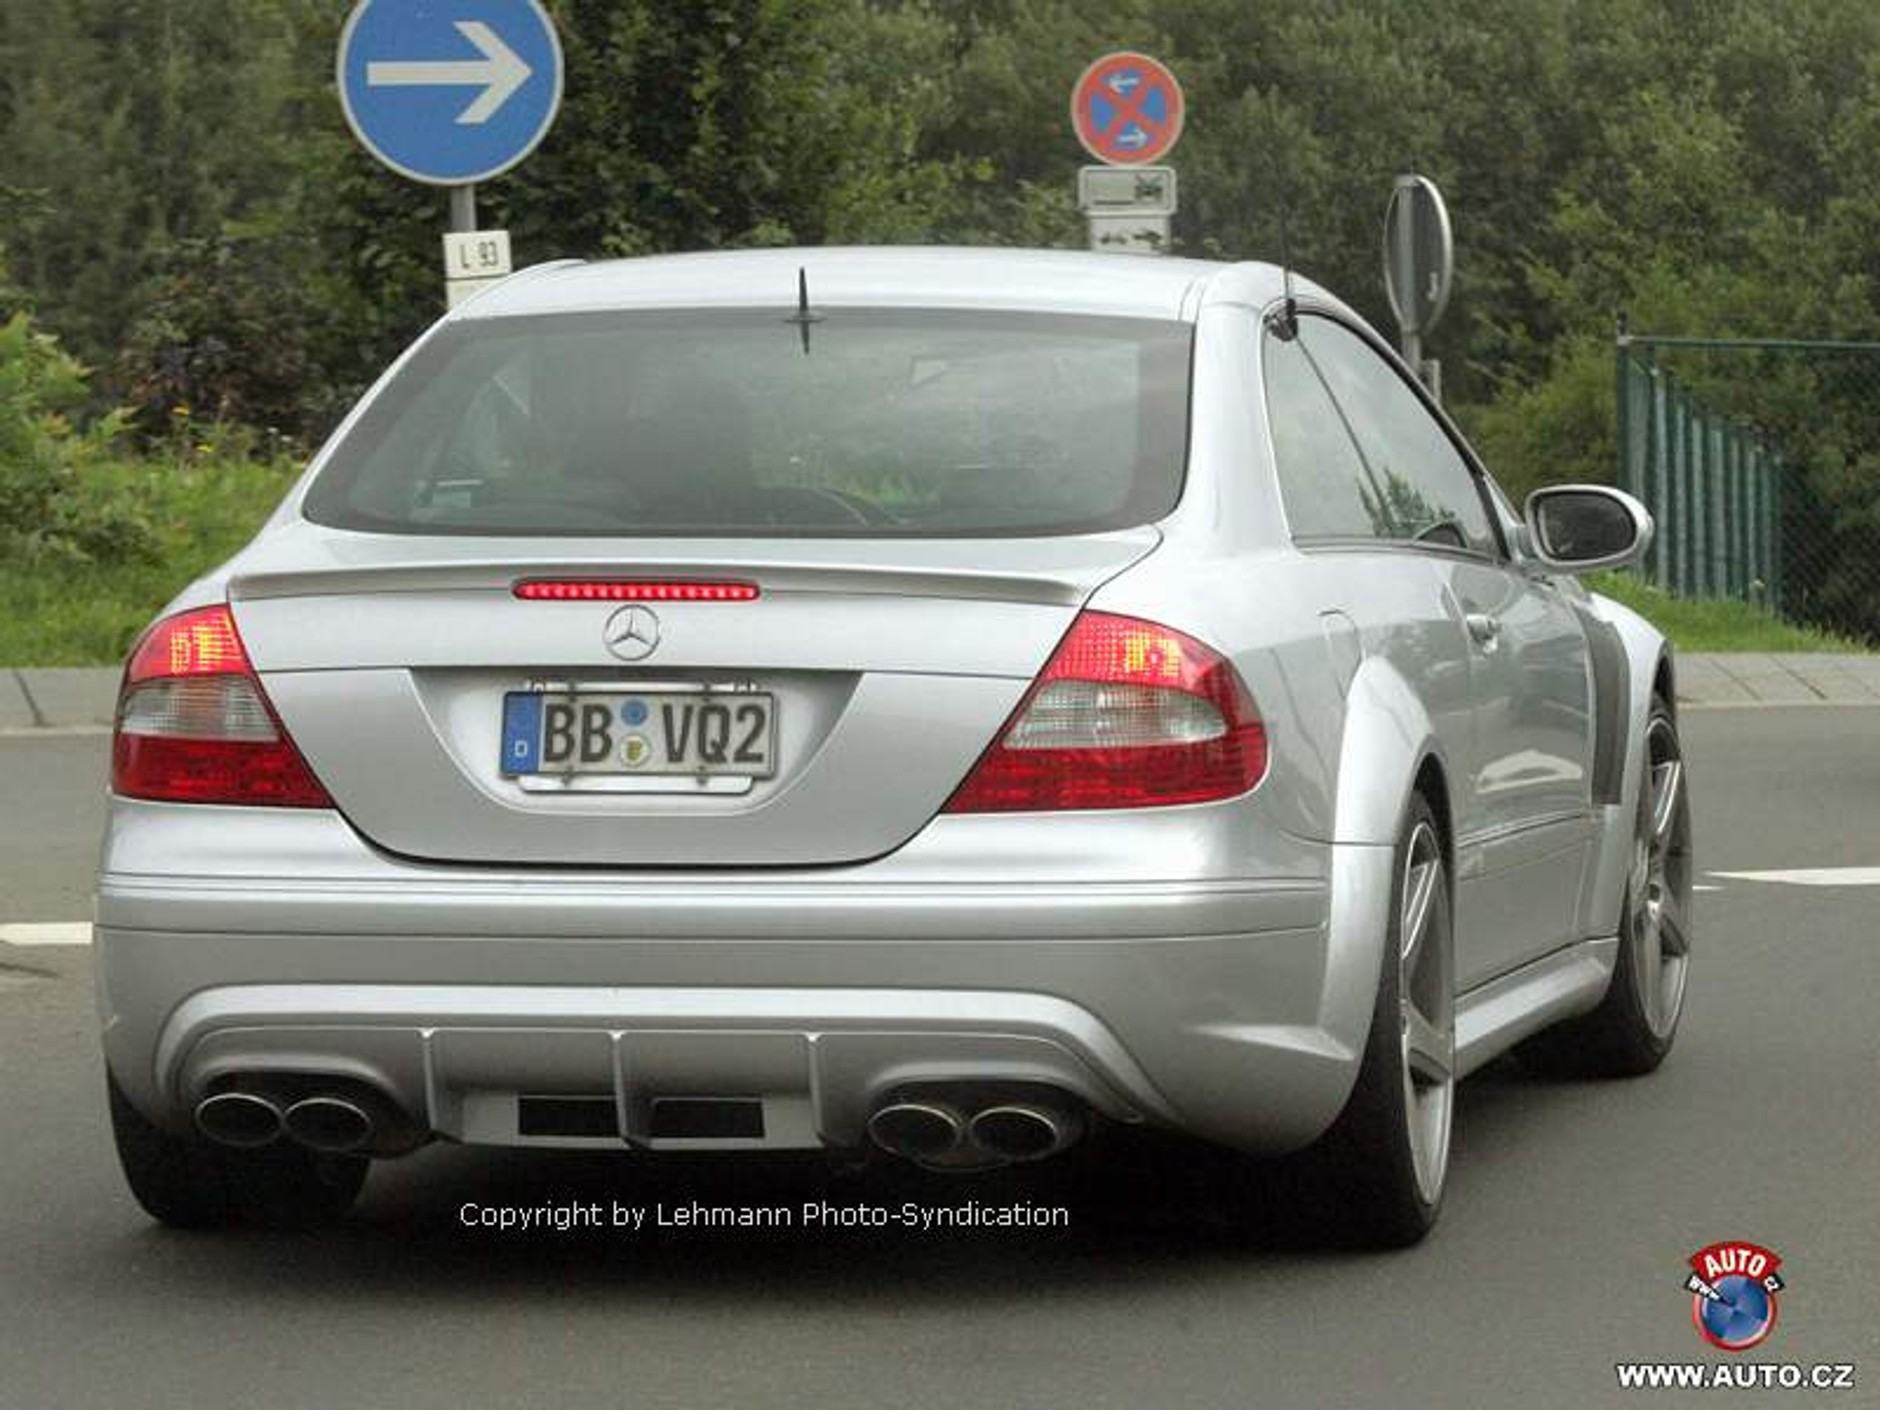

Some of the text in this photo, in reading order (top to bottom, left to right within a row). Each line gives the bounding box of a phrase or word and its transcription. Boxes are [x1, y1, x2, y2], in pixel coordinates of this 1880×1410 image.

[460, 242, 498, 269] L 93
[543, 703, 766, 764] BB VQ2
